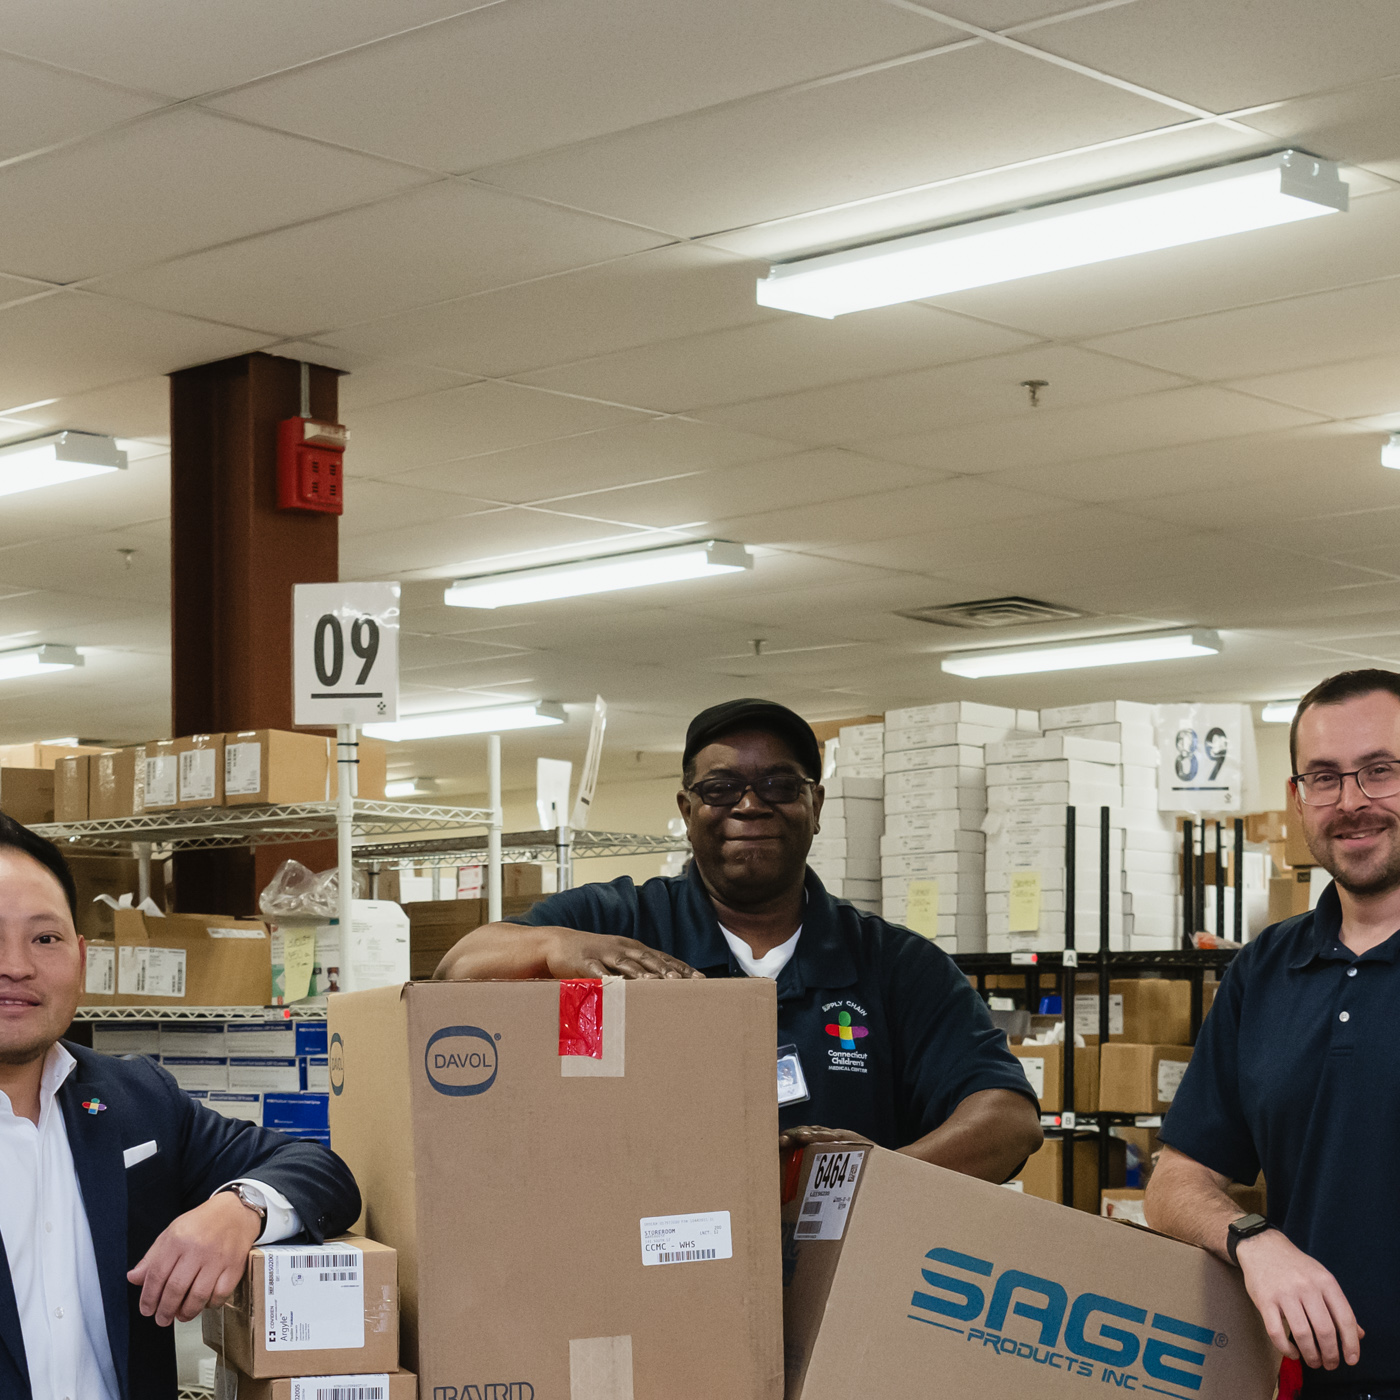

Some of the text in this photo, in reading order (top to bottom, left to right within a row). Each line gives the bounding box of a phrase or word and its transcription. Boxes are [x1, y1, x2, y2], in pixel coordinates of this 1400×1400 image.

[314, 613, 380, 687] 09
[1175, 726, 1229, 783] 89
[1067, 954, 1074, 963] A
[846, 1000, 868, 1017] CHAIN
[433, 1051, 494, 1070] DAVOL
[827, 1049, 868, 1060] Connecticut
[831, 1057, 864, 1067] Children's
[1065, 1116, 1072, 1125] B
[814, 1153, 851, 1190] 6464
[644, 1228, 676, 1236] STOREROOM
[645, 1242, 667, 1252] CCMC
[679, 1241, 696, 1249] WHS
[967, 1327, 1139, 1391] PRODUCTS INC
